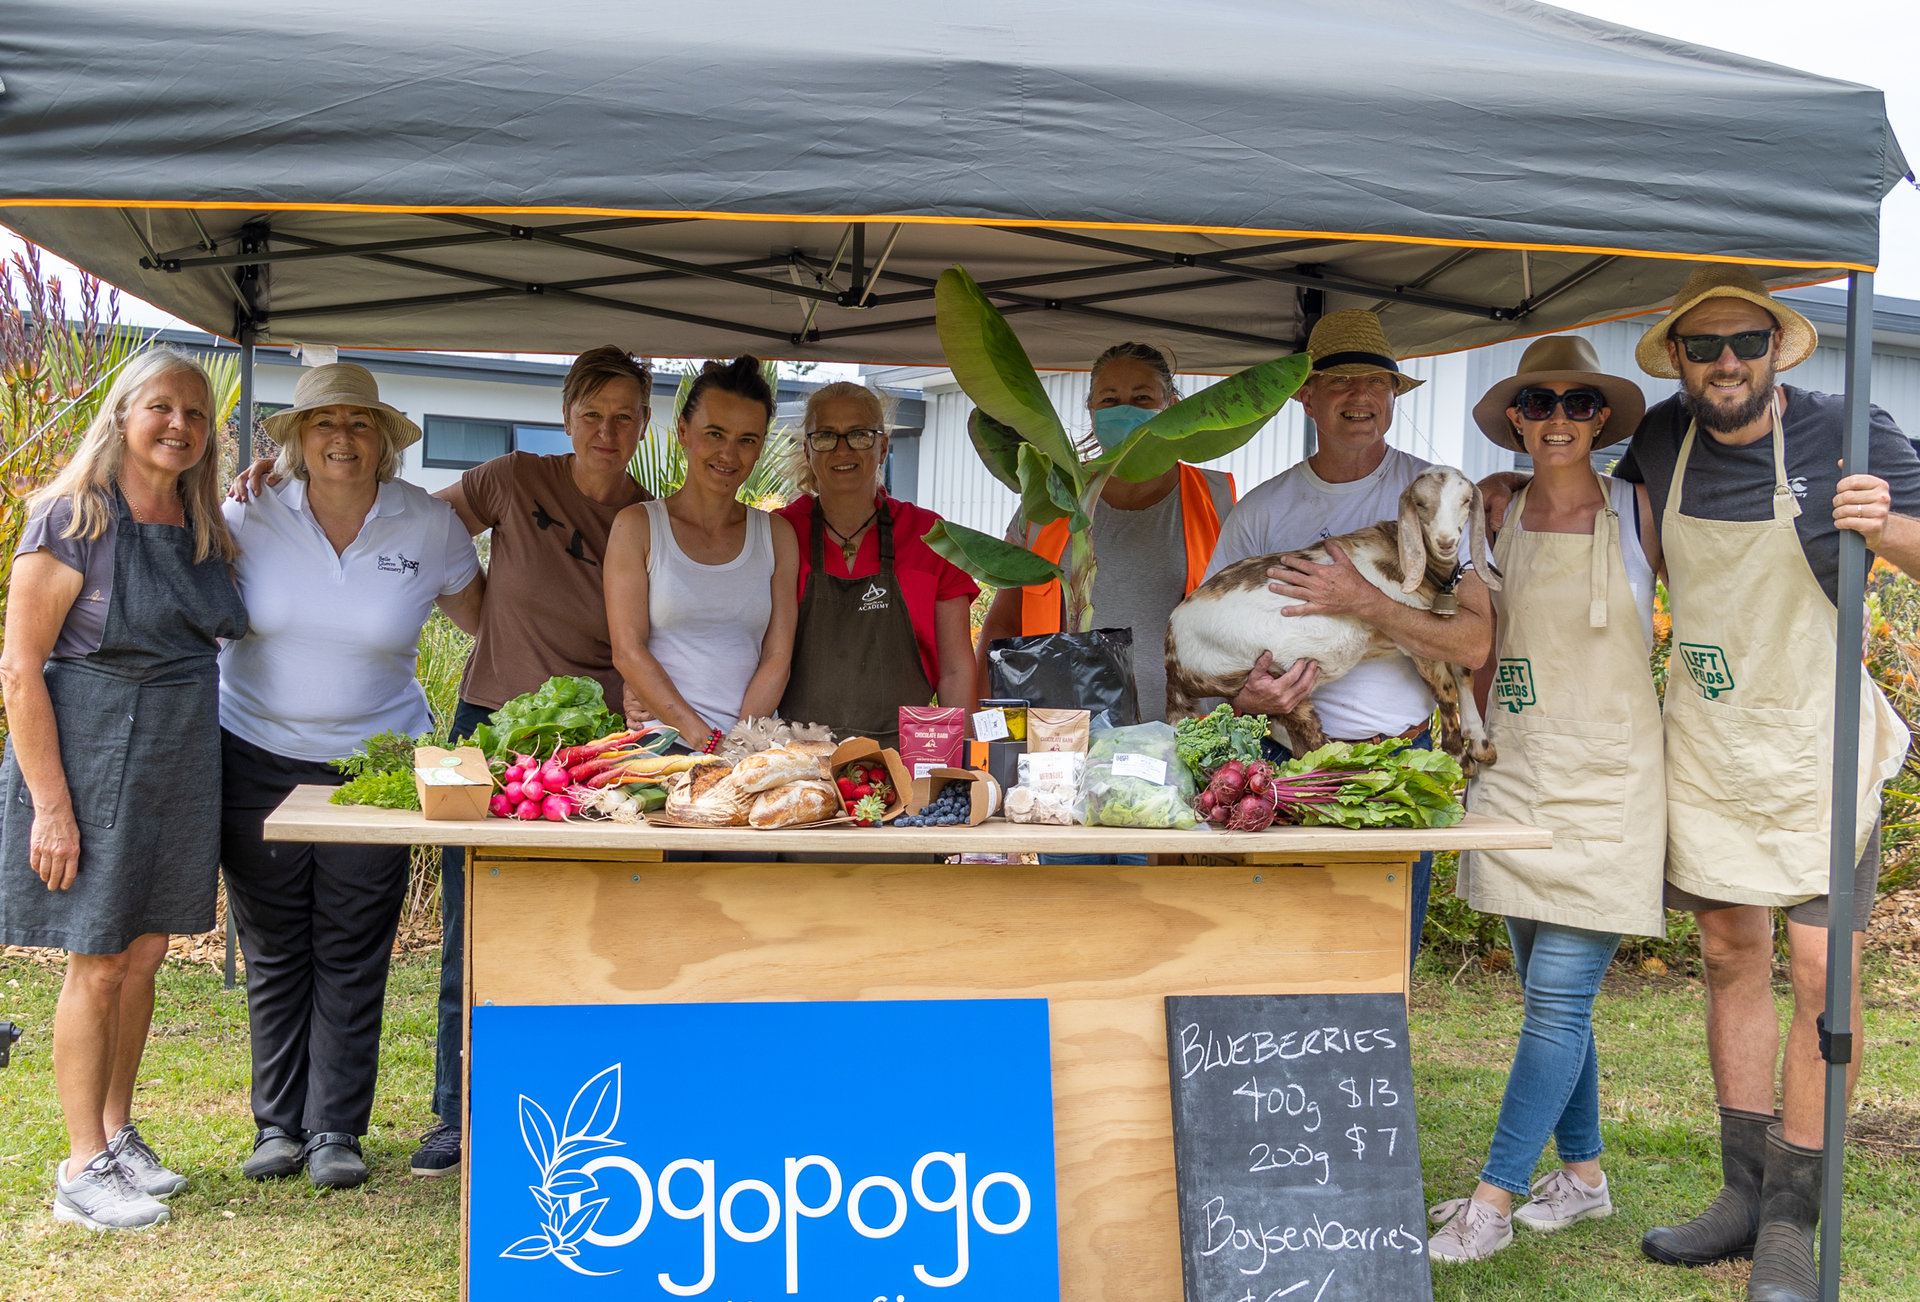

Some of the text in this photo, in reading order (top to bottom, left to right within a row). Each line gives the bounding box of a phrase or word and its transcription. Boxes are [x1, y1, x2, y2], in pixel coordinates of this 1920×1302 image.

[858, 603, 889, 611] ACADEMY
[1684, 650, 1717, 670] LEFT
[1180, 1023, 1397, 1079] BLUEBERRIES
[1233, 1076, 1399, 1132] 400g $13
[1249, 1143, 1329, 1185] 200g
[568, 1151, 1032, 1297] Ogopogo
[1200, 1195, 1423, 1275] Boysenberries
